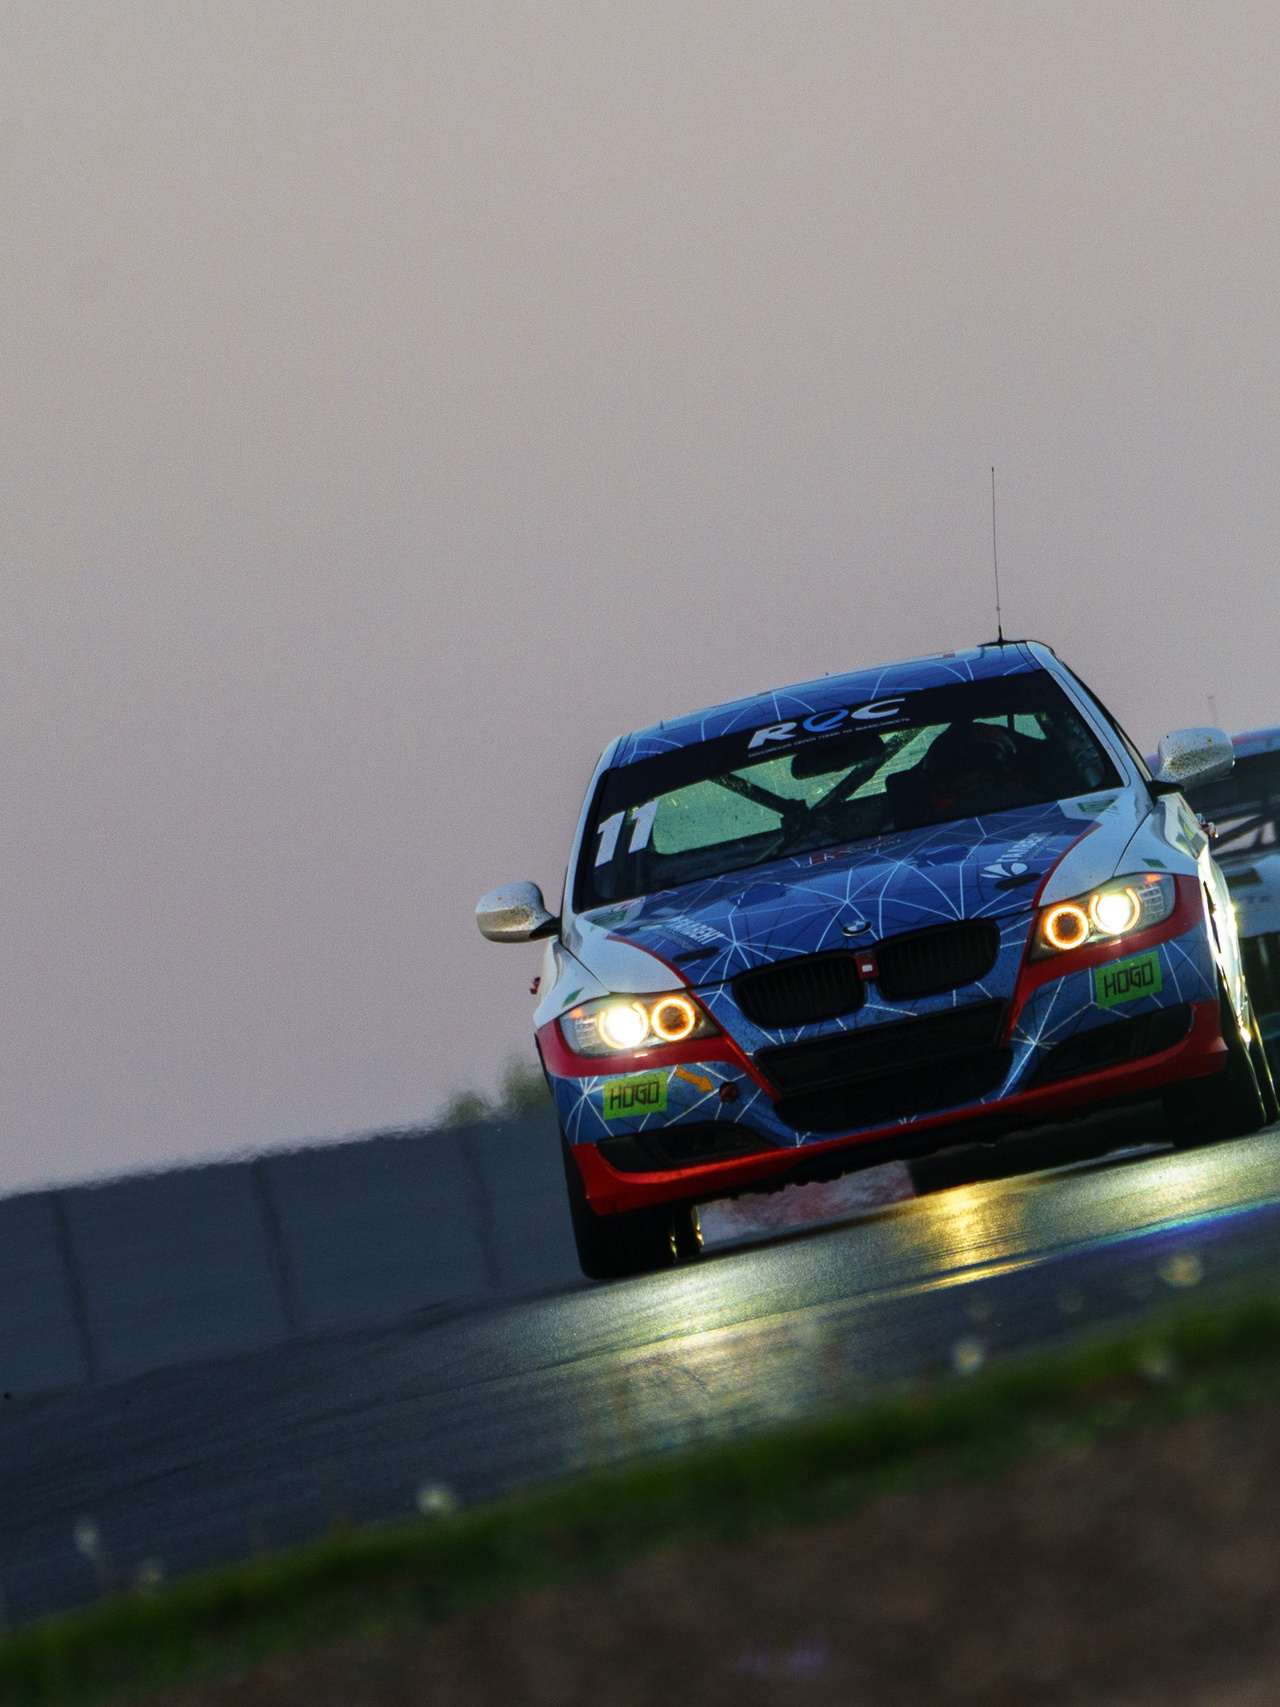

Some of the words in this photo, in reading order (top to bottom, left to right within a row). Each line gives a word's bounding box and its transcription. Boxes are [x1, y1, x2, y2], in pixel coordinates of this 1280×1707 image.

[594, 798, 660, 868] 11
[1103, 958, 1155, 999] HOGO
[609, 1081, 660, 1111] HOGO
